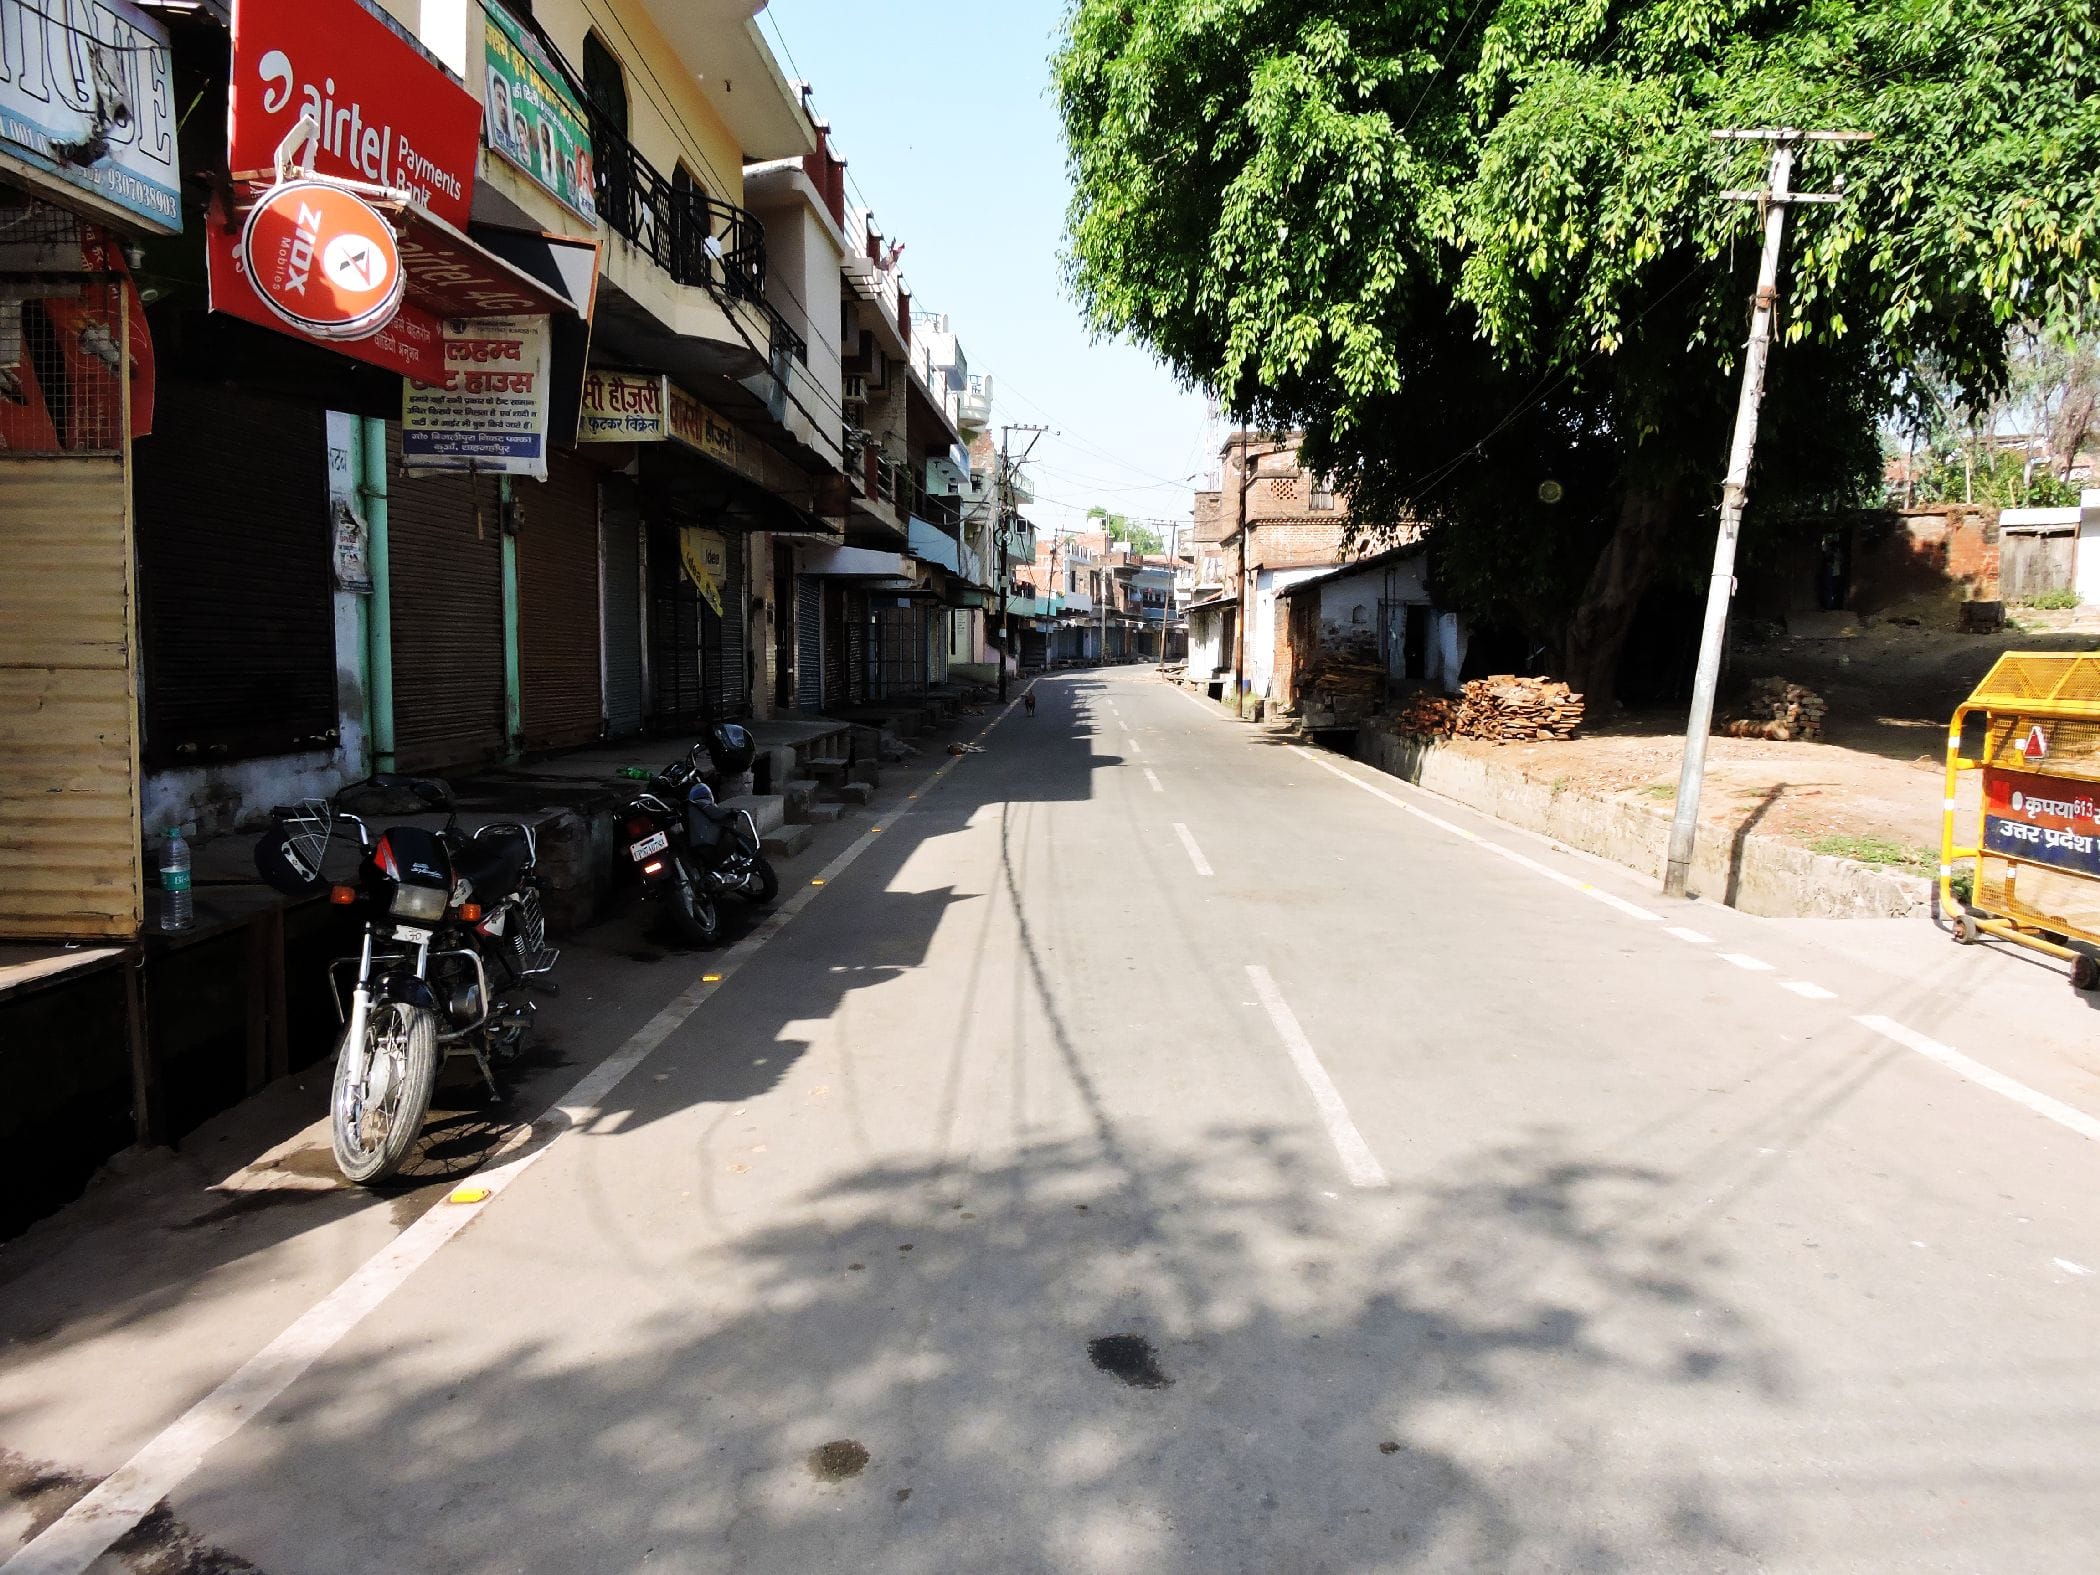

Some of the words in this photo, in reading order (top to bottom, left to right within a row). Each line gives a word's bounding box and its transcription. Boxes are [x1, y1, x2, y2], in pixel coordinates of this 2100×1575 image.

[300, 77, 391, 187] airtel
[398, 134, 461, 201] Payments
[108, 169, 177, 219] 9307038903
[396, 168, 433, 209] Bank
[272, 237, 291, 291] Mobiles
[285, 200, 322, 297] ZIOX
[443, 338, 523, 362] लहम्द
[464, 371, 534, 394] हाउस
[583, 374, 604, 411] सी
[588, 415, 624, 434] फुटकर
[625, 414, 660, 434] विक्रेता
[2024, 796, 2075, 819] कृपया
[2073, 797, 2093, 818] 613
[1999, 820, 2041, 843] उत्तर
[2043, 827, 2094, 854] प्रदेश
